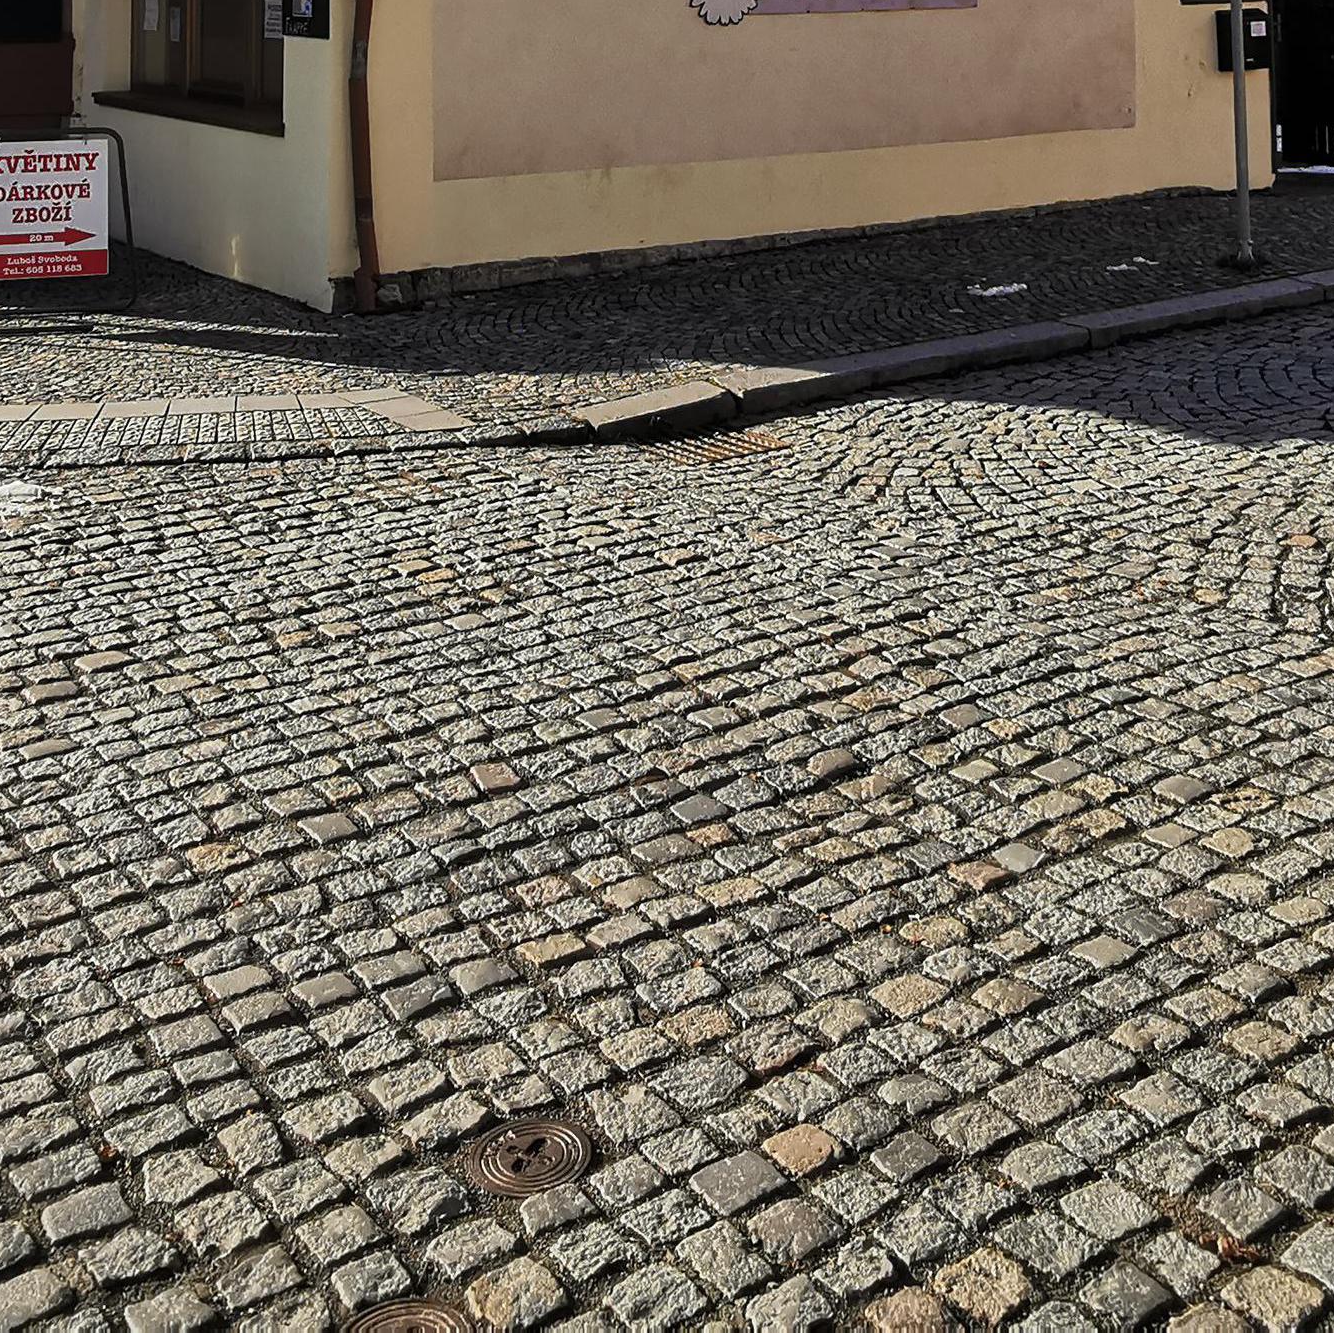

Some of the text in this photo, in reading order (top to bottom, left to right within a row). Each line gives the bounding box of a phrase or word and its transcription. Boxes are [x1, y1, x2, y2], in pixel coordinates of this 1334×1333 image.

[11, 201, 72, 224] ZBOŽÍ
[29, 234, 54, 242] 20 m
[7, 254, 78, 265] Luboš Svoboda
